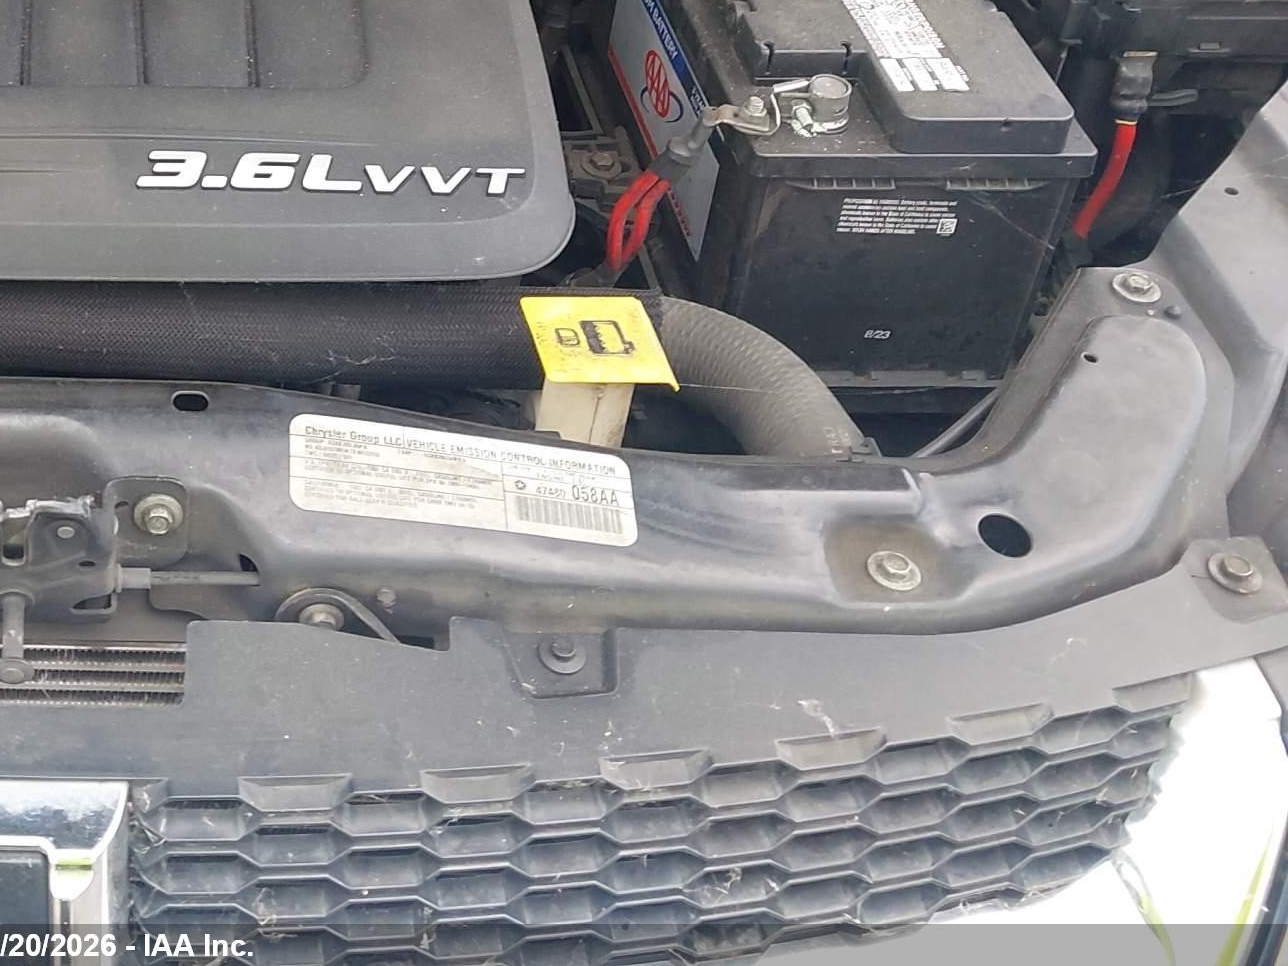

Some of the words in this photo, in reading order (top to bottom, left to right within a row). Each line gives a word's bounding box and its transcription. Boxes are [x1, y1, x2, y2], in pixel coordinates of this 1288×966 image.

[652, 8, 679, 60] BATTERY
[305, 425, 346, 439] Chrysler
[350, 431, 380, 445] Group
[383, 436, 403, 447] LLC
[406, 439, 446, 452] VEHICLE
[450, 445, 497, 459] EMISSION
[500, 451, 546, 466] CONTROL
[549, 458, 617, 476] INFORMATION
[571, 485, 620, 507] 058AA
